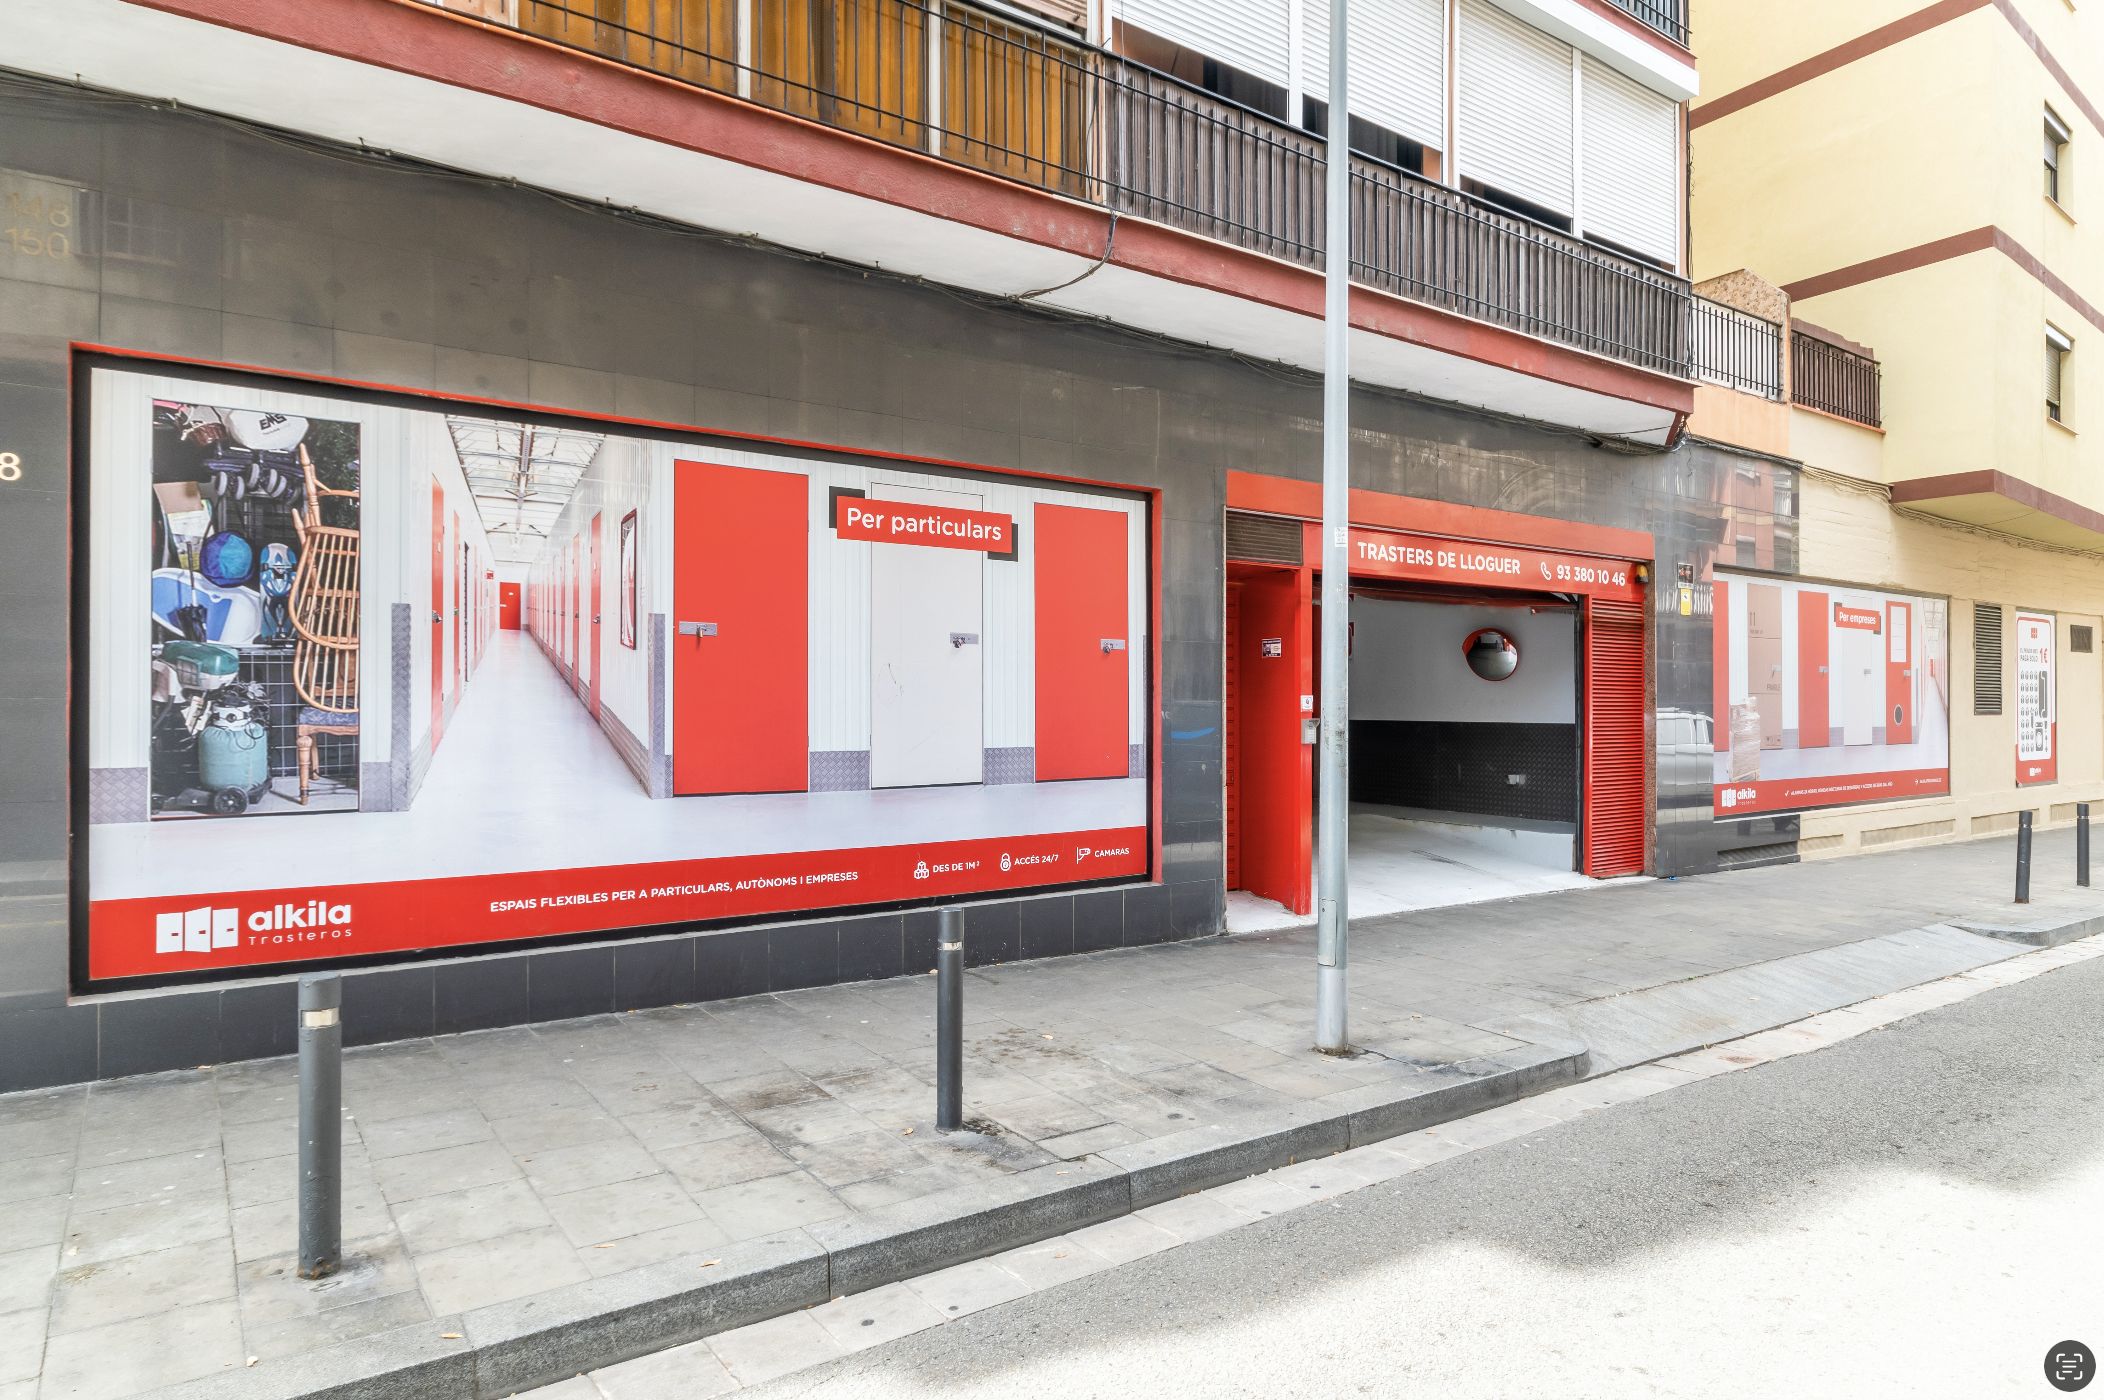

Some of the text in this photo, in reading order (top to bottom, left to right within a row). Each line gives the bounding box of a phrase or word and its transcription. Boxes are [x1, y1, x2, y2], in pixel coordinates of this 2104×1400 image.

[5, 192, 70, 228] 148
[5, 226, 69, 259] 150
[847, 507, 1002, 541] Per particulars
[1357, 542, 1521, 574] TRASTERS DE LLOGUER
[1557, 565, 1626, 587] 93 380 10 46
[1839, 611, 1877, 625] Per empreses
[1737, 787, 1756, 800] alkila
[1014, 854, 1059, 866] ACCÉS 24/7
[1094, 847, 1130, 858] CAMARAS
[932, 863, 949, 873] DES
[951, 862, 963, 872] DE
[490, 871, 858, 913] ESPAIS FLEXIBLES PER A PARTICULARS, AUTÒNOMS I EMPRESES
[247, 900, 351, 931] alkila
[248, 929, 352, 945] Trasteros
